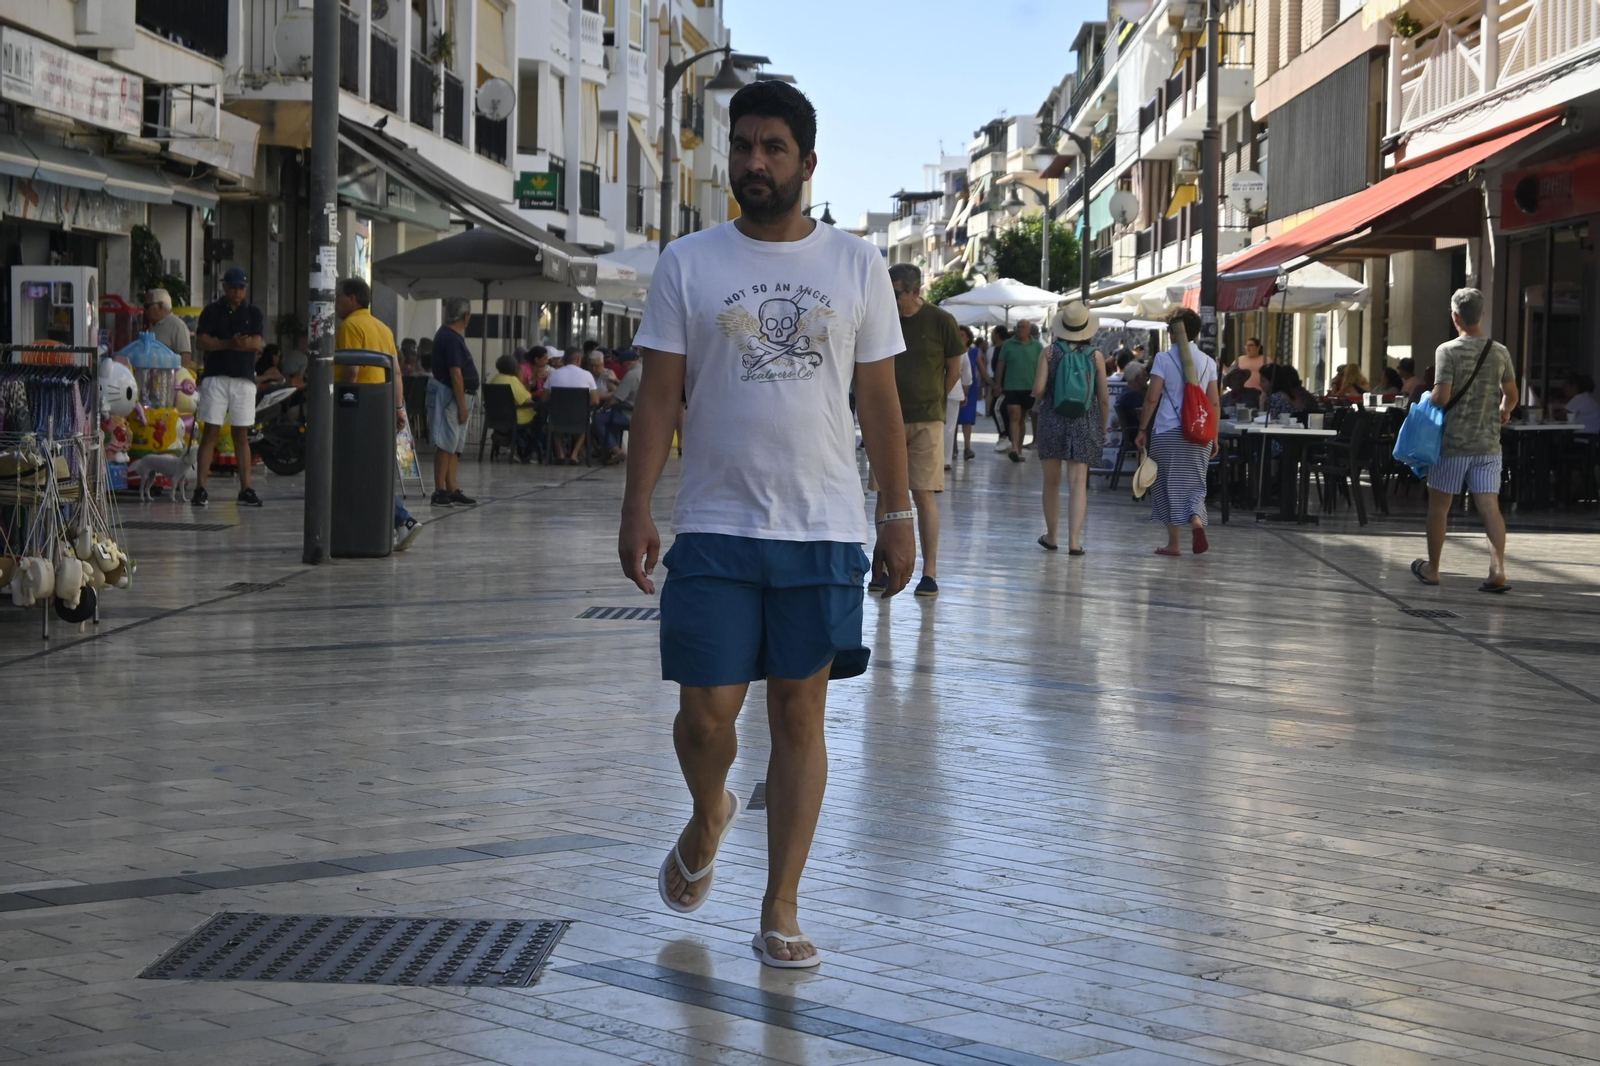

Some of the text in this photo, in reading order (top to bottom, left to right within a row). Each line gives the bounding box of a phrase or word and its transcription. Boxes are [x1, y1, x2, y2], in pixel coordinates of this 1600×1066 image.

[723, 283, 832, 308] NOT SO AN ANGEL
